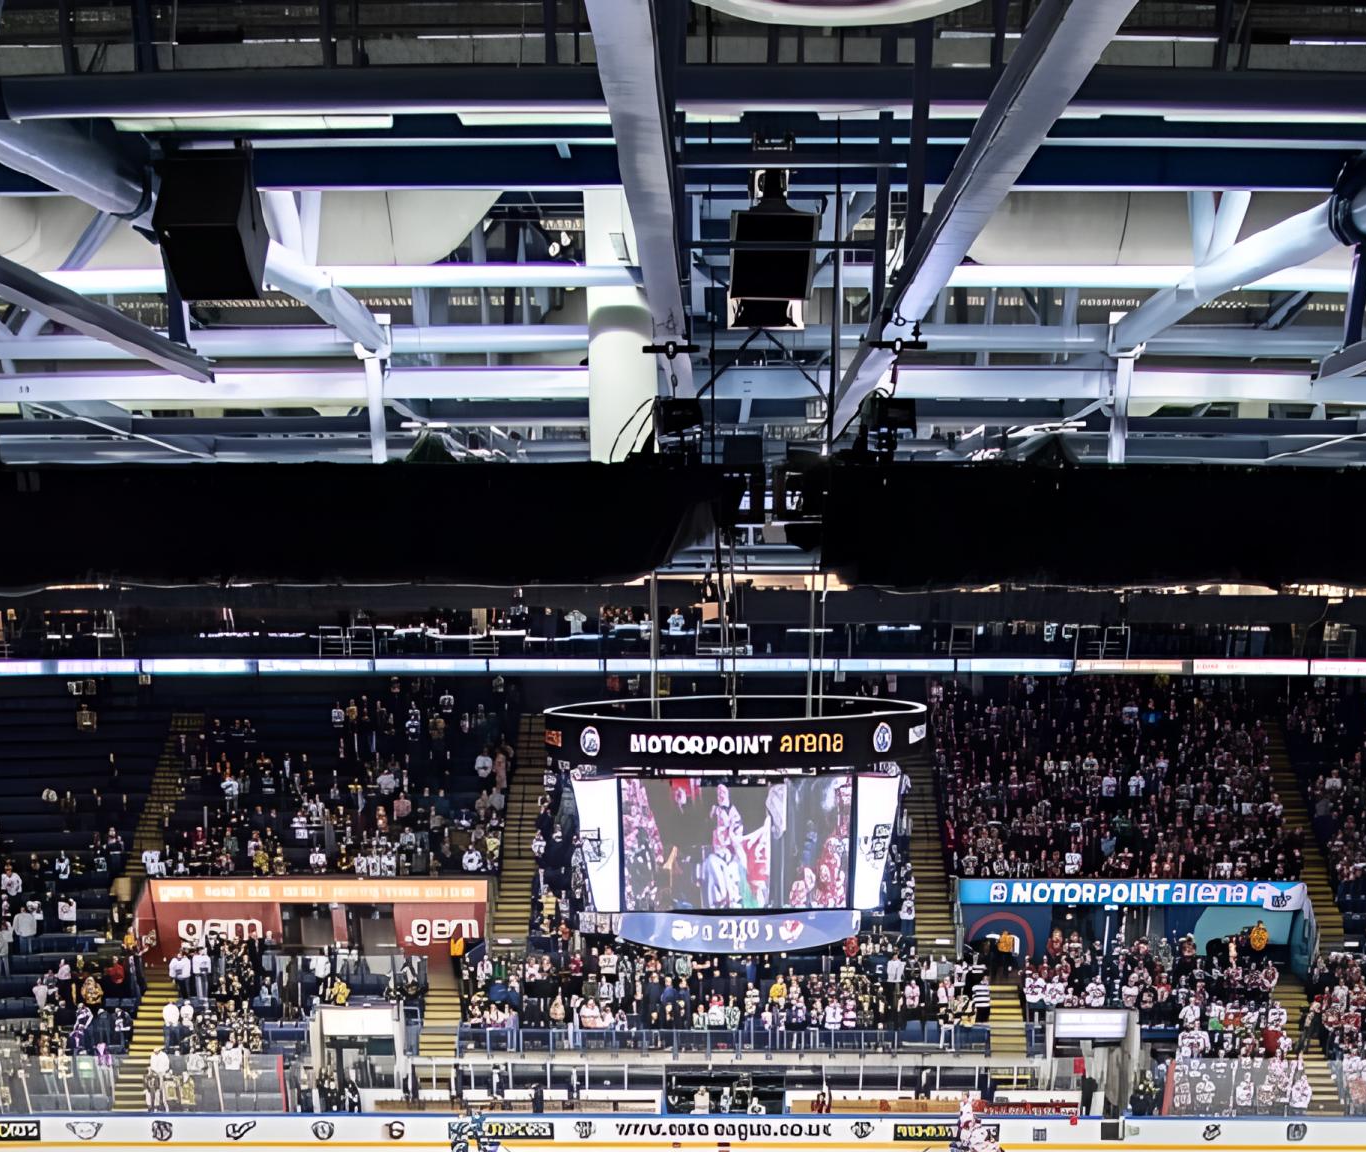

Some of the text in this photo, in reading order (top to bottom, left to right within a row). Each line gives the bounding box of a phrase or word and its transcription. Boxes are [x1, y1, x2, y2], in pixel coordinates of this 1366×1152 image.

[629, 733, 844, 755] MOTORPOINT arena
[1171, 882, 1249, 903] arena
